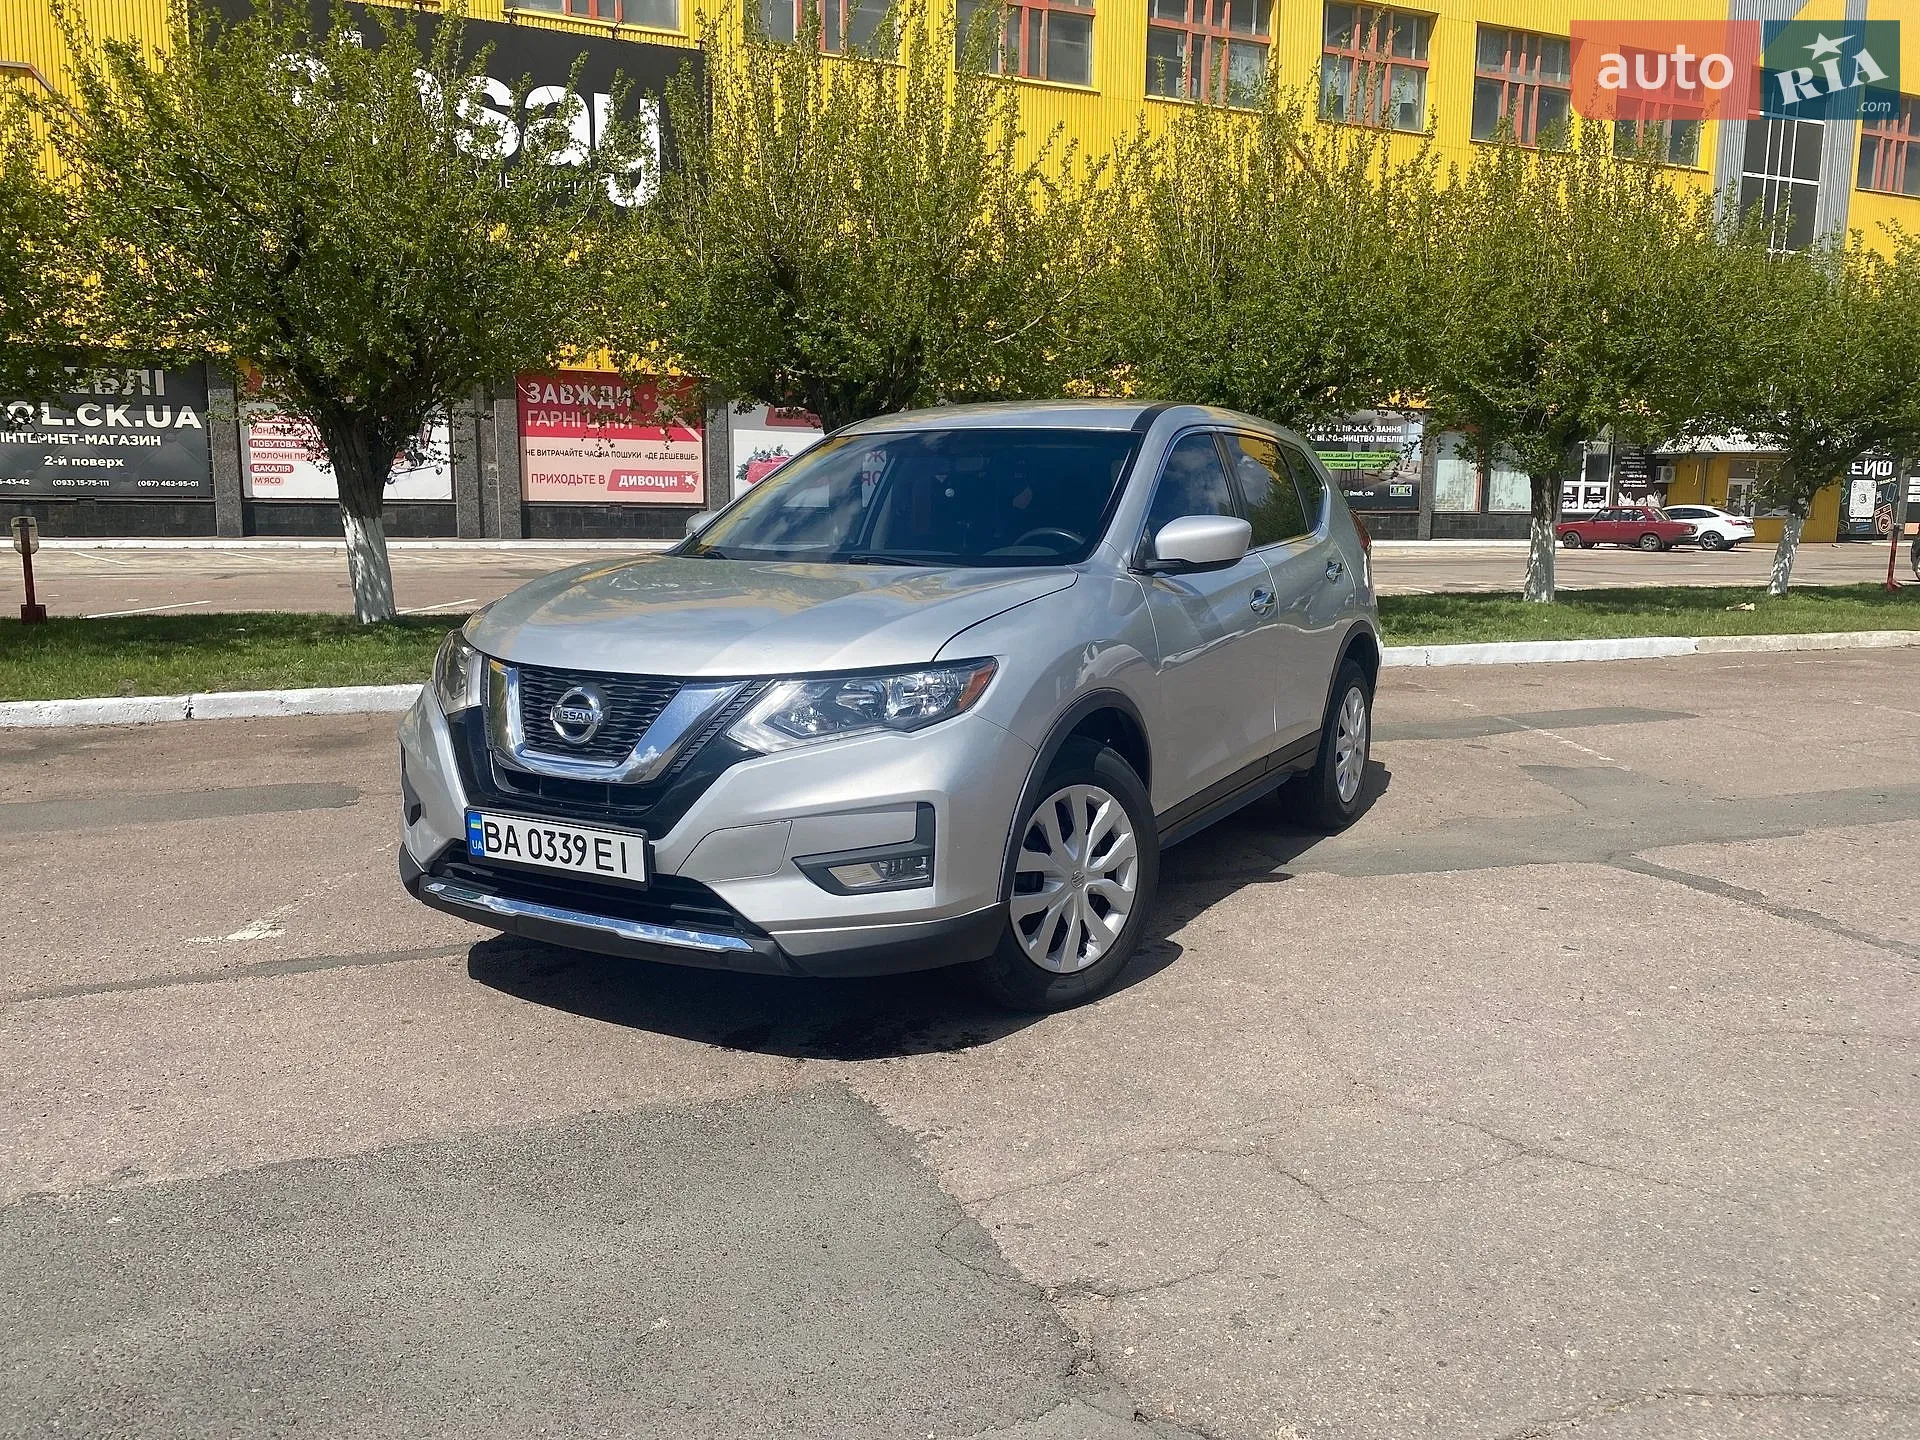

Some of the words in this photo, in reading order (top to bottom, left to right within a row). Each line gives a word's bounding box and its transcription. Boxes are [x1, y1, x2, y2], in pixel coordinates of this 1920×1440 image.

[527, 382, 632, 409] ЗАВЖДИ
[0, 400, 202, 429] OL.CK.UA
[527, 410, 581, 428] ГАРНІ
[586, 412, 633, 430] ЦНИ
[252, 440, 297, 448] ПОБУТОВА
[525, 449, 536, 457] НЕ
[537, 448, 583, 458] ВИТРАЧАЙТЕ
[599, 450, 610, 458] НА
[611, 451, 642, 459] ПОШУКИ
[43, 455, 68, 467] 2-й
[71, 457, 125, 469] поверх
[1847, 457, 1893, 480] ЕЙШ
[52, 479, 75, 488] (093)
[531, 473, 596, 486] ПРИХОДЬТЕ
[599, 474, 606, 485] В
[618, 475, 678, 488] ДИВОЦІН
[554, 707, 594, 724] NISSAN
[471, 839, 484, 851] UA
[483, 821, 522, 857] BA
[527, 827, 588, 866] 0339
[594, 837, 628, 874] EI
